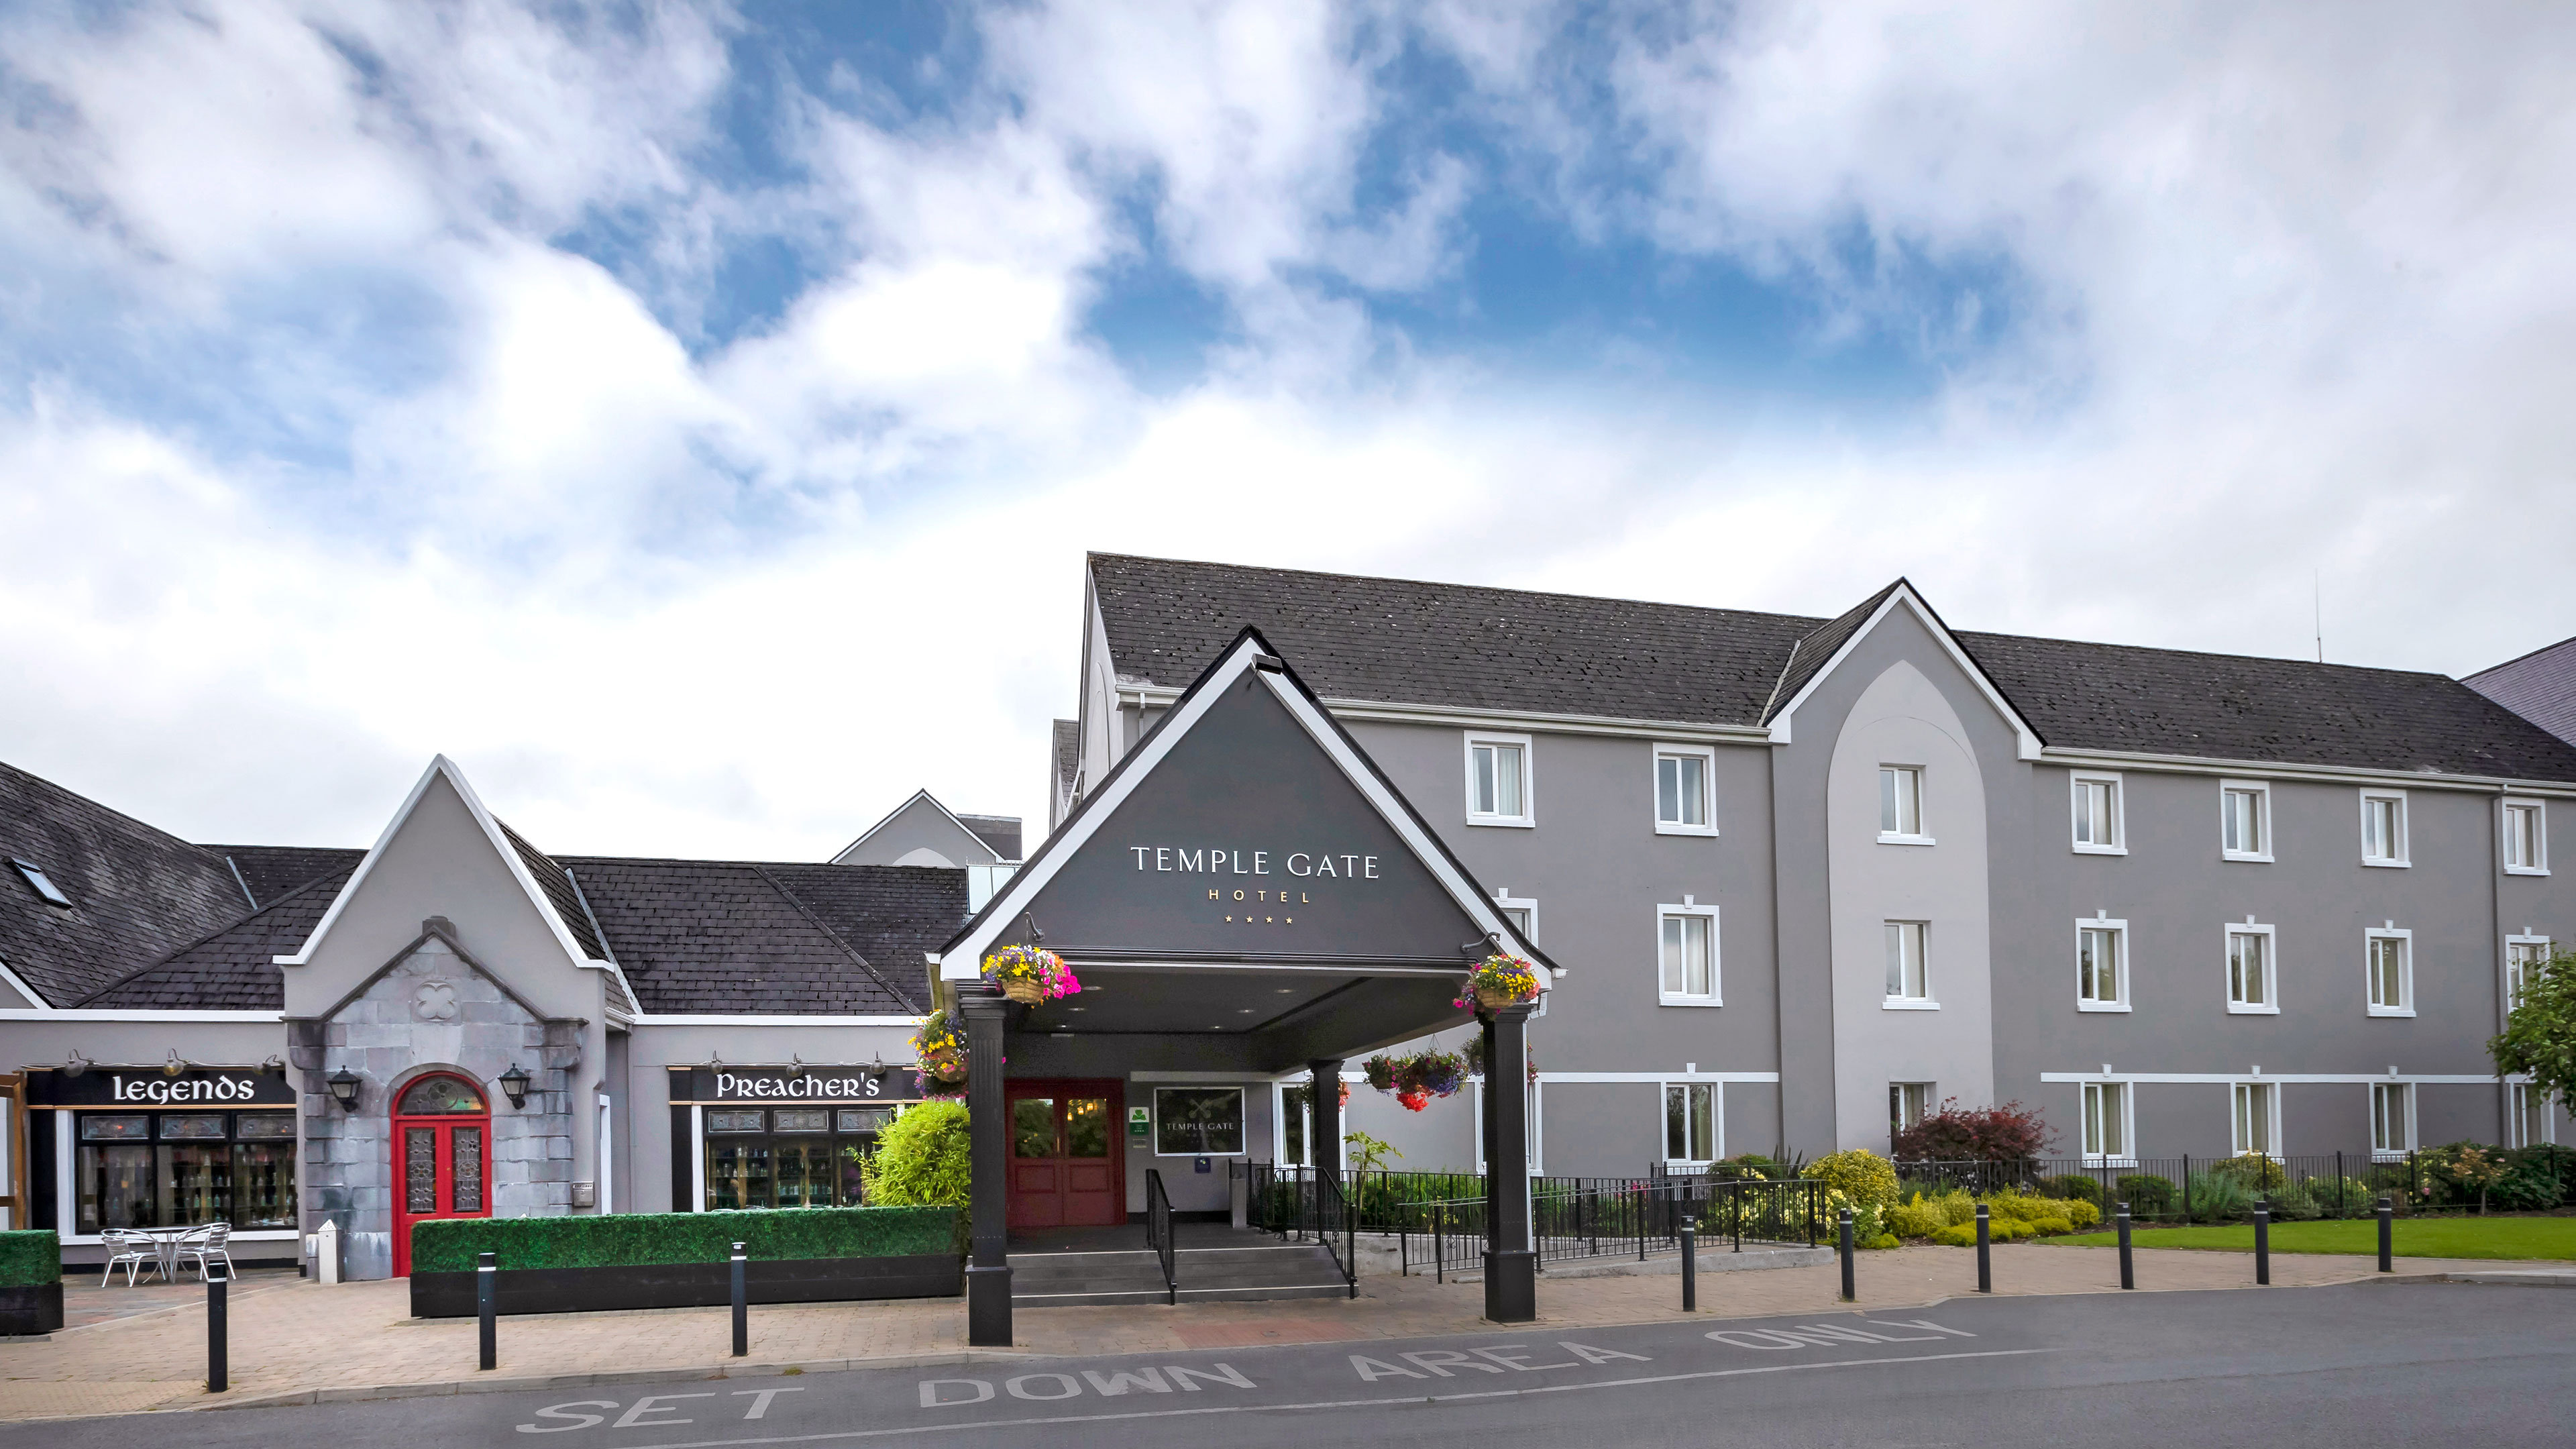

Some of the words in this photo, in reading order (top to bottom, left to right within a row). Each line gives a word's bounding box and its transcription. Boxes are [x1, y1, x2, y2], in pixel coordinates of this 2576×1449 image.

[1130, 846, 1270, 875] TEMPLE
[1287, 852, 1380, 879] GATE
[1208, 889, 1309, 903] HOTEL
[1167, 1122, 1203, 1130] TEMPLE
[515, 1387, 805, 1433] SET
[918, 1363, 1257, 1407] DOWN
[1348, 1341, 1653, 1381] AREA
[1705, 1319, 1978, 1350] ONLY
